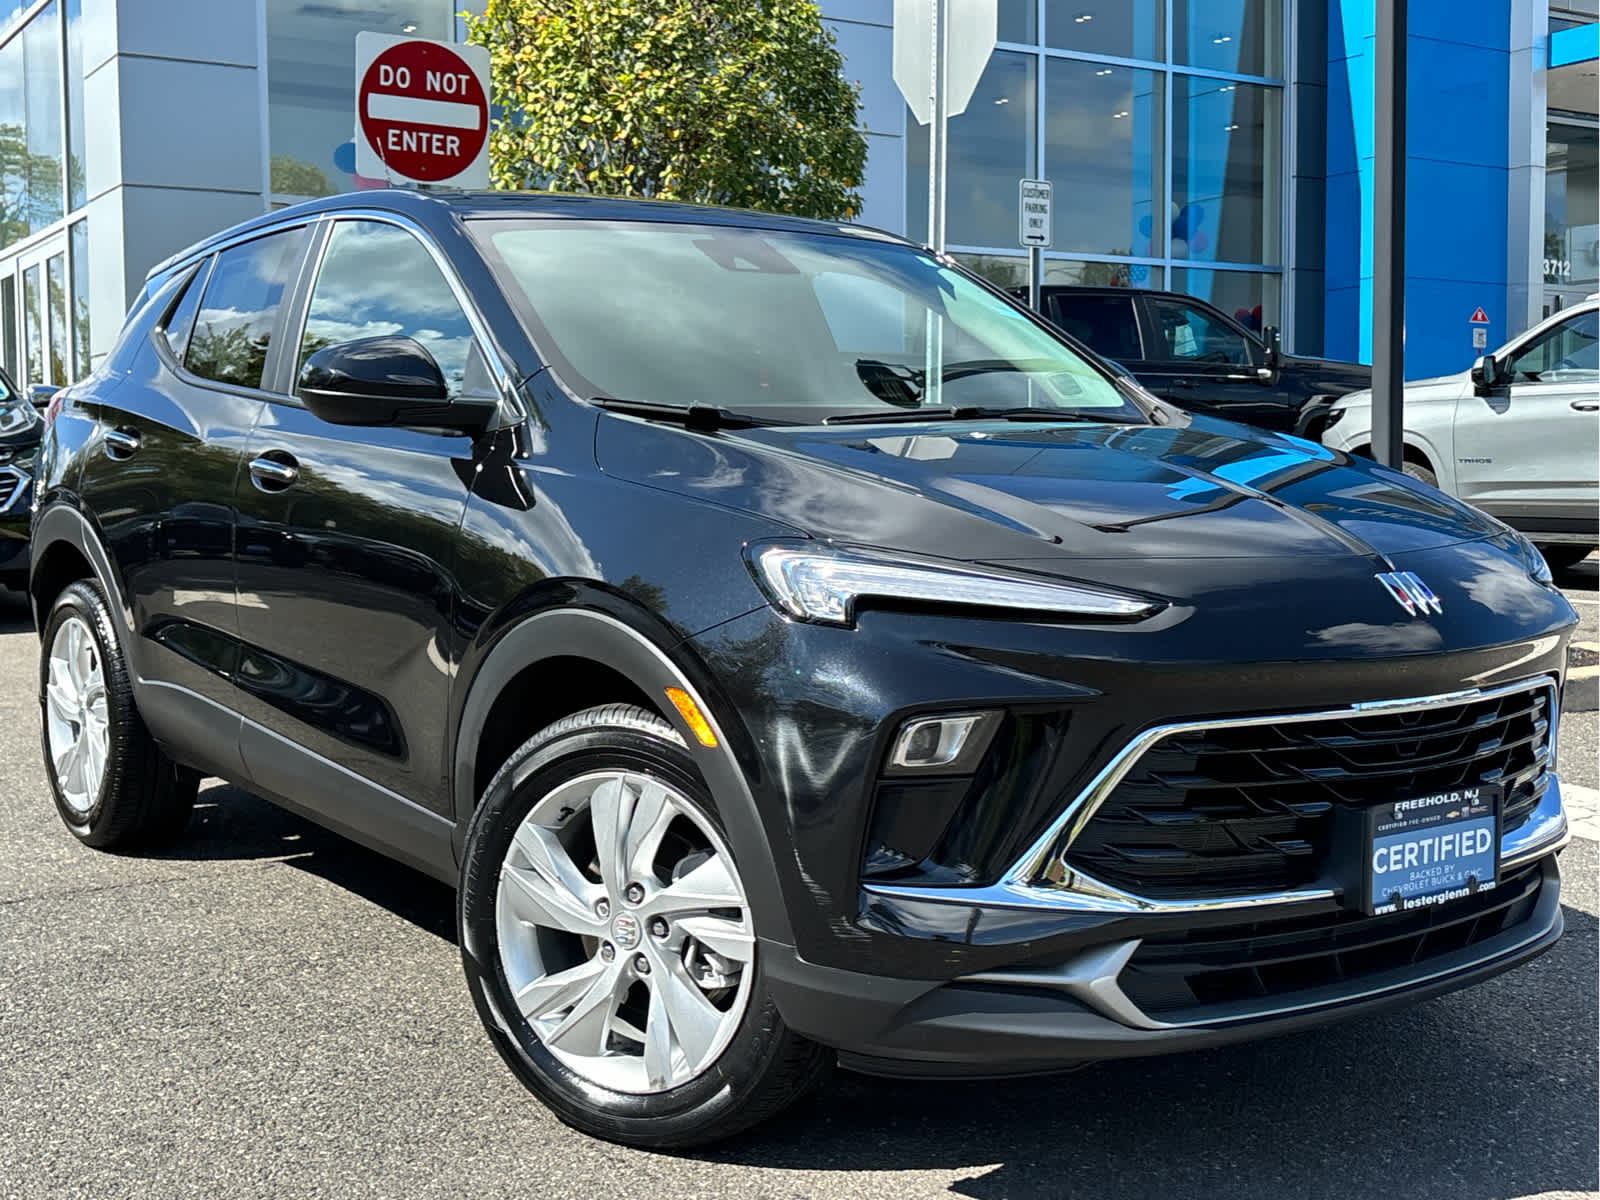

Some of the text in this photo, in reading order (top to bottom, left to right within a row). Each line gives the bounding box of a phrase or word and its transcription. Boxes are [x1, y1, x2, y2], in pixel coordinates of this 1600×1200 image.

[379, 64, 470, 95] DO NOT
[388, 128, 460, 157] ENTER
[1025, 202, 1048, 214] PARKING
[1028, 217, 1043, 229] ONLY
[1543, 259, 1571, 276] 3712
[1394, 788, 1480, 812] FREEHOLD, NJ
[1372, 828, 1492, 874] CERTIFIED
[1409, 864, 1455, 881] BACKED BY
[1382, 879, 1429, 897] CHEVROLET
[1431, 873, 1456, 887] BUICK
